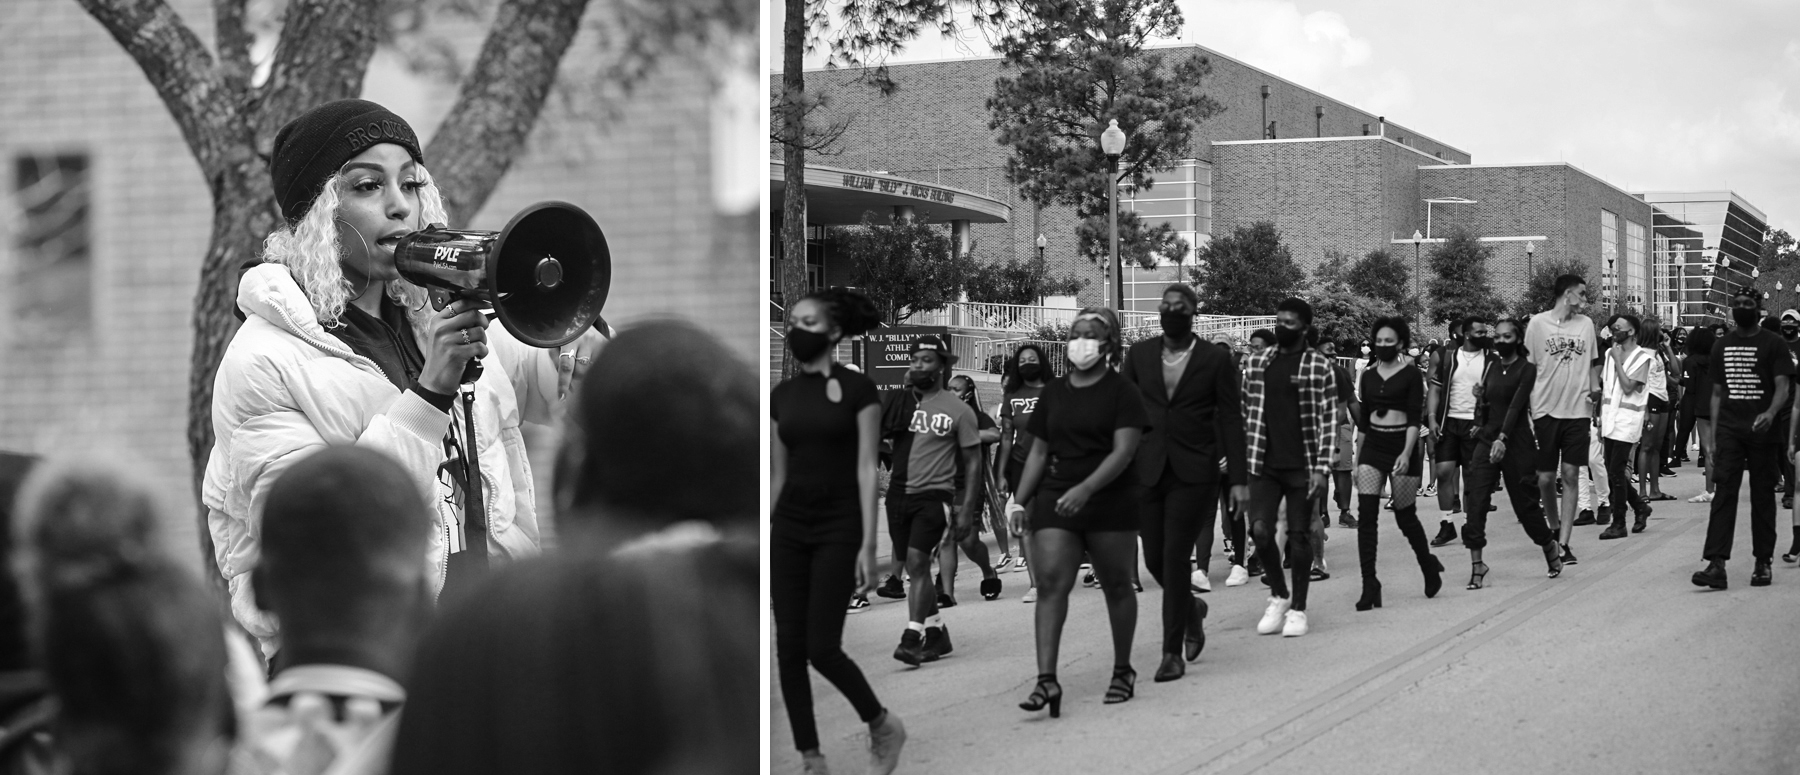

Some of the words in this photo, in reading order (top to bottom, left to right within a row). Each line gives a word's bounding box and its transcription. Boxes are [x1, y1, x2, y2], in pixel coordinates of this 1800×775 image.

[842, 174, 875, 191] WILLIAM
[434, 246, 461, 263] PYLE
[869, 334, 878, 342] W.
[879, 334, 885, 342] J.
[885, 333, 915, 342] "BILLY"
[885, 343, 913, 352] ATHLE
[885, 353, 912, 362] COMPL
